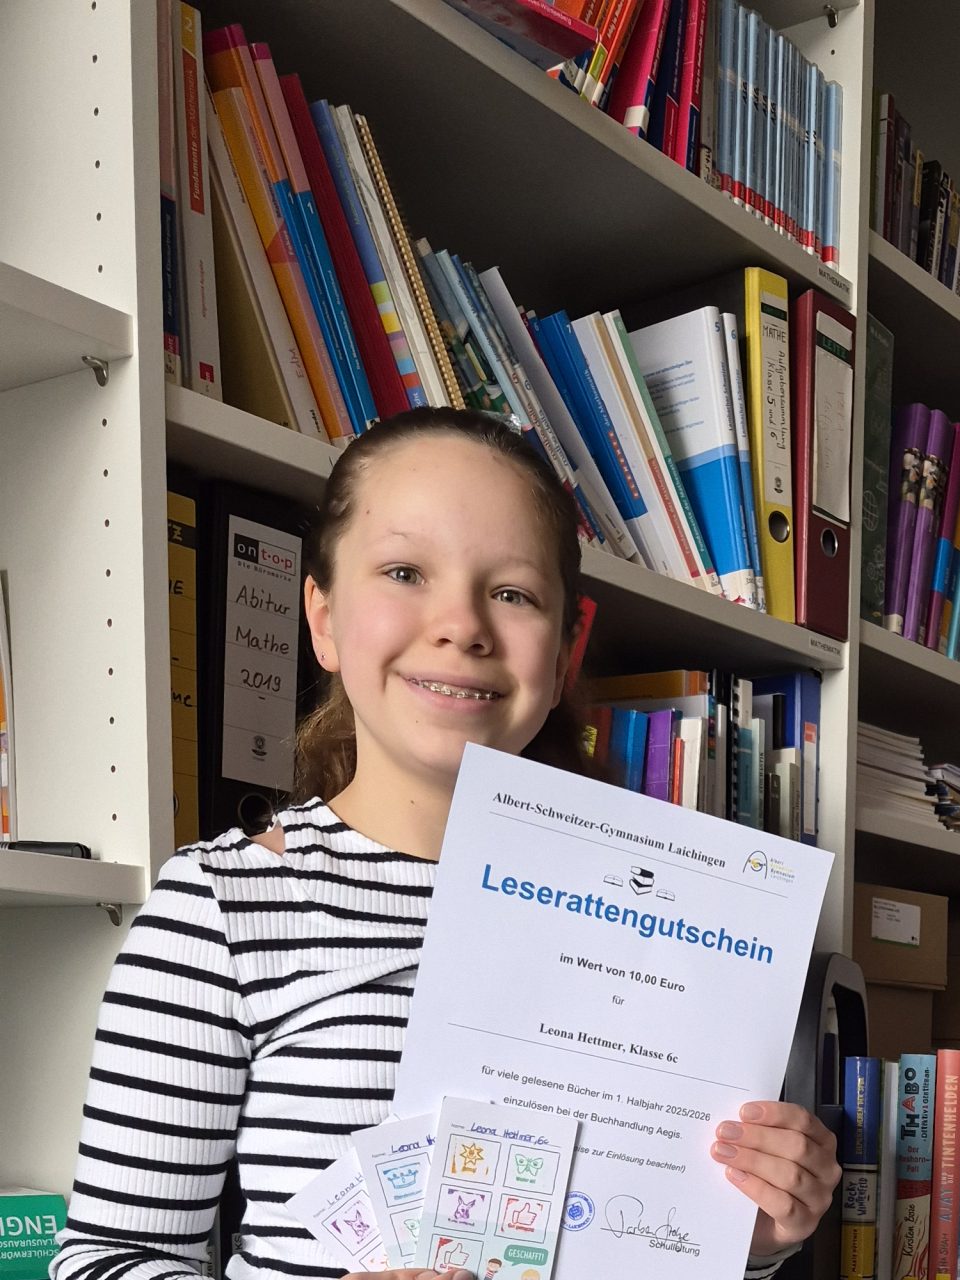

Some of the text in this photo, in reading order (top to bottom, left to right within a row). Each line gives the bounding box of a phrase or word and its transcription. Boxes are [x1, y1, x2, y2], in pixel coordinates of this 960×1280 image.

[190, 140, 202, 201] Fundamente
[762, 324, 787, 344] MATHE
[766, 361, 776, 392] Klasse
[766, 395, 776, 407] 5
[235, 585, 291, 616] Abitur
[235, 625, 290, 656] Mathe
[240, 668, 282, 692] 2019
[492, 791, 727, 869] Albert-Schweitzer-Gymnasium Laichingen
[481, 863, 774, 964] Leserattengutschein
[560, 952, 686, 993] im Wert von 10,00 Euro
[612, 994, 625, 1006] für
[539, 1022, 679, 1064] Leona Hettmer, Klasse 6c
[481, 1064, 711, 1122] für viele gelesene Bücher im 1. Halbjahr 2025/2026
[900, 1066, 921, 1141] THABO
[470, 1122, 497, 1136] Leona
[503, 1094, 683, 1140] einzulösen bei der Buchhandlung Aegis.
[942, 1074, 960, 1169] TINTENHELDEN
[391, 1141, 420, 1154] Leona
[591, 1148, 605, 1157] zur
[605, 1150, 645, 1166] Einlösung
[645, 1154, 686, 1174] beachten!)
[327, 1181, 355, 1206] Leona
[939, 1189, 953, 1223] AJAY
[508, 1248, 546, 1262] GESCHAFFT!
[902, 1223, 915, 1257] Kirsten
